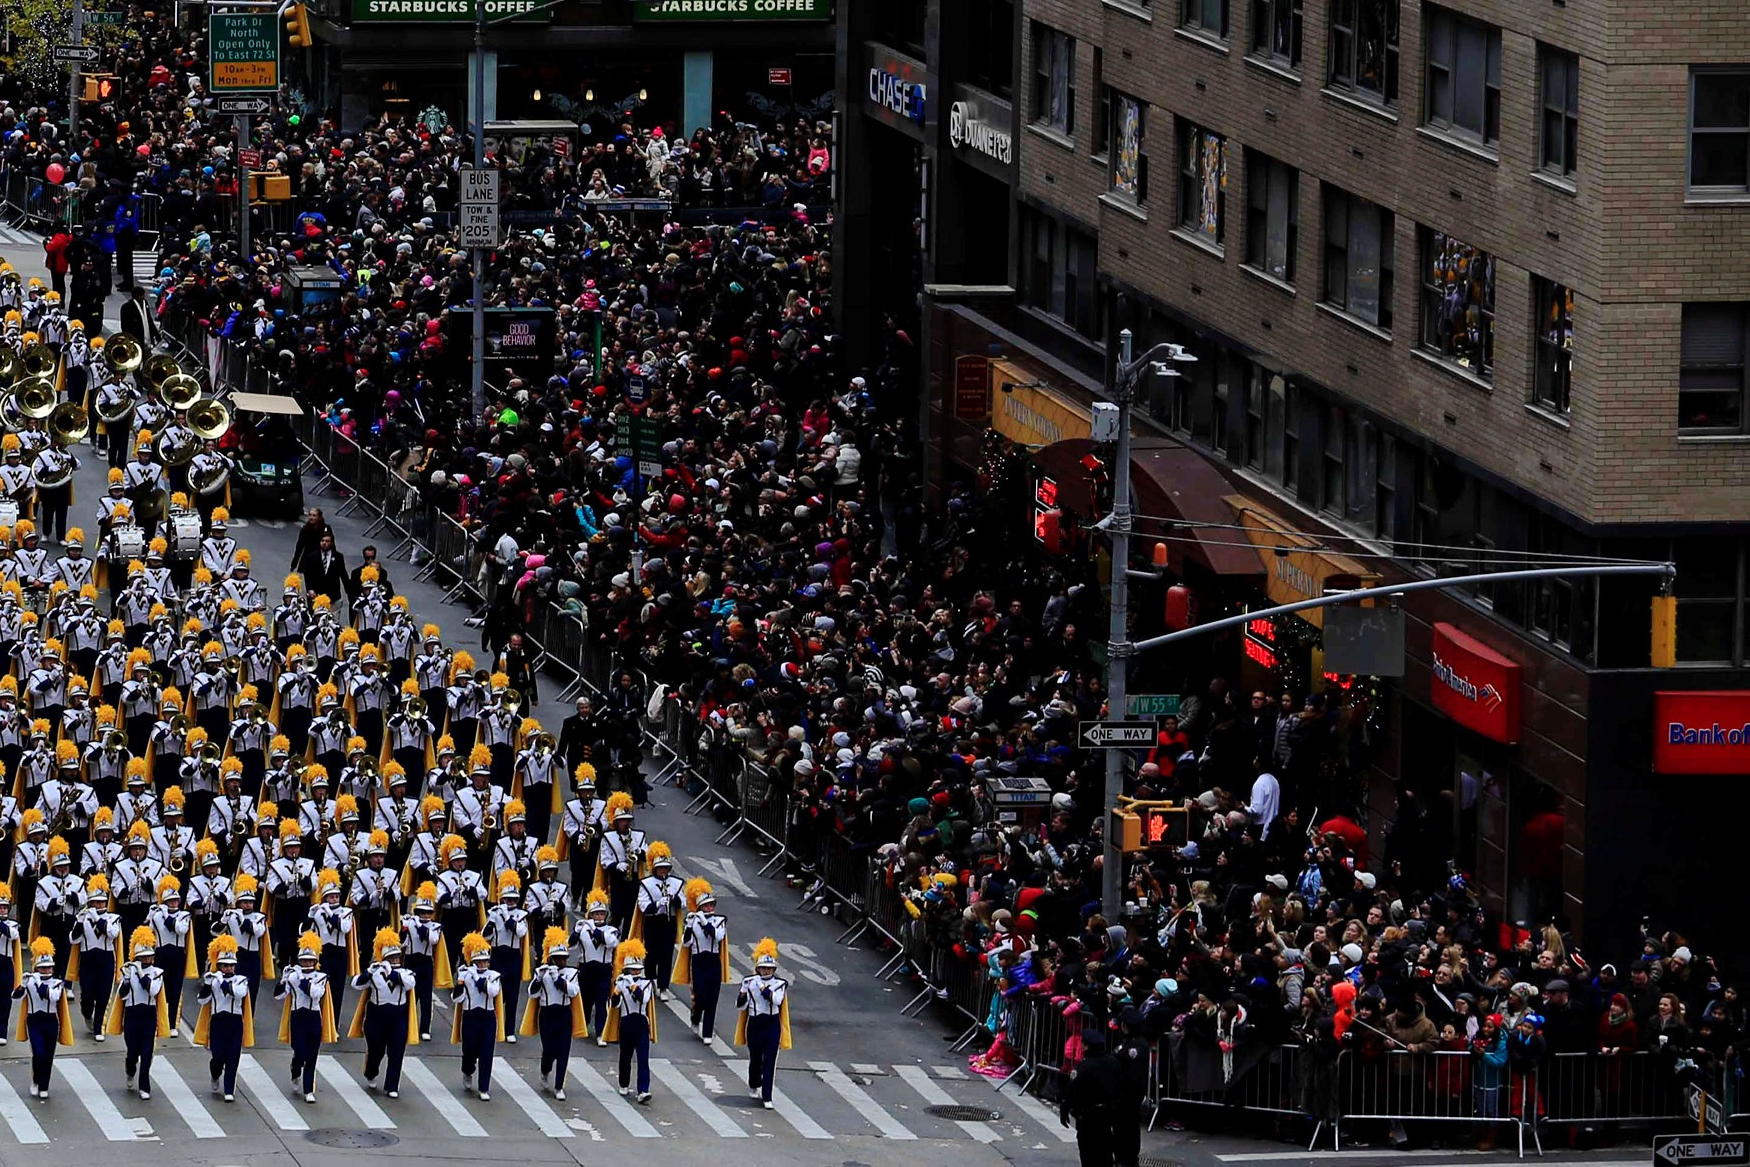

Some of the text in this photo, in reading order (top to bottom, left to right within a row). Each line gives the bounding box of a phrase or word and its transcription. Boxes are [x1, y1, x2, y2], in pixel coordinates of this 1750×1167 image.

[369, 0, 468, 13] STARBUCKS
[754, 0, 815, 11] COFFEE
[92, 13, 100, 22] W
[104, 14, 115, 22] 56
[225, 18, 262, 27] Park Dr
[230, 28, 259, 38] North
[218, 39, 270, 50] Open Only
[214, 50, 275, 60] To East 72 St
[218, 76, 238, 85] Mon
[258, 75, 272, 84] Fri
[870, 68, 912, 118] CHASE
[470, 174, 490, 185] BUS
[466, 189, 493, 200] LANE
[466, 206, 483, 214] TOW
[470, 215, 488, 223] FINE
[510, 323, 530, 335] GOOD
[502, 335, 536, 345] BEHAVIOR
[1140, 697, 1149, 712] W
[1152, 697, 1165, 712] 55
[1091, 729, 1147, 739] ONE WAY
[1668, 722, 1726, 745] Bank
[1011, 793, 1037, 801] TITAN
[1666, 1143, 1741, 1158] ONE WAY
